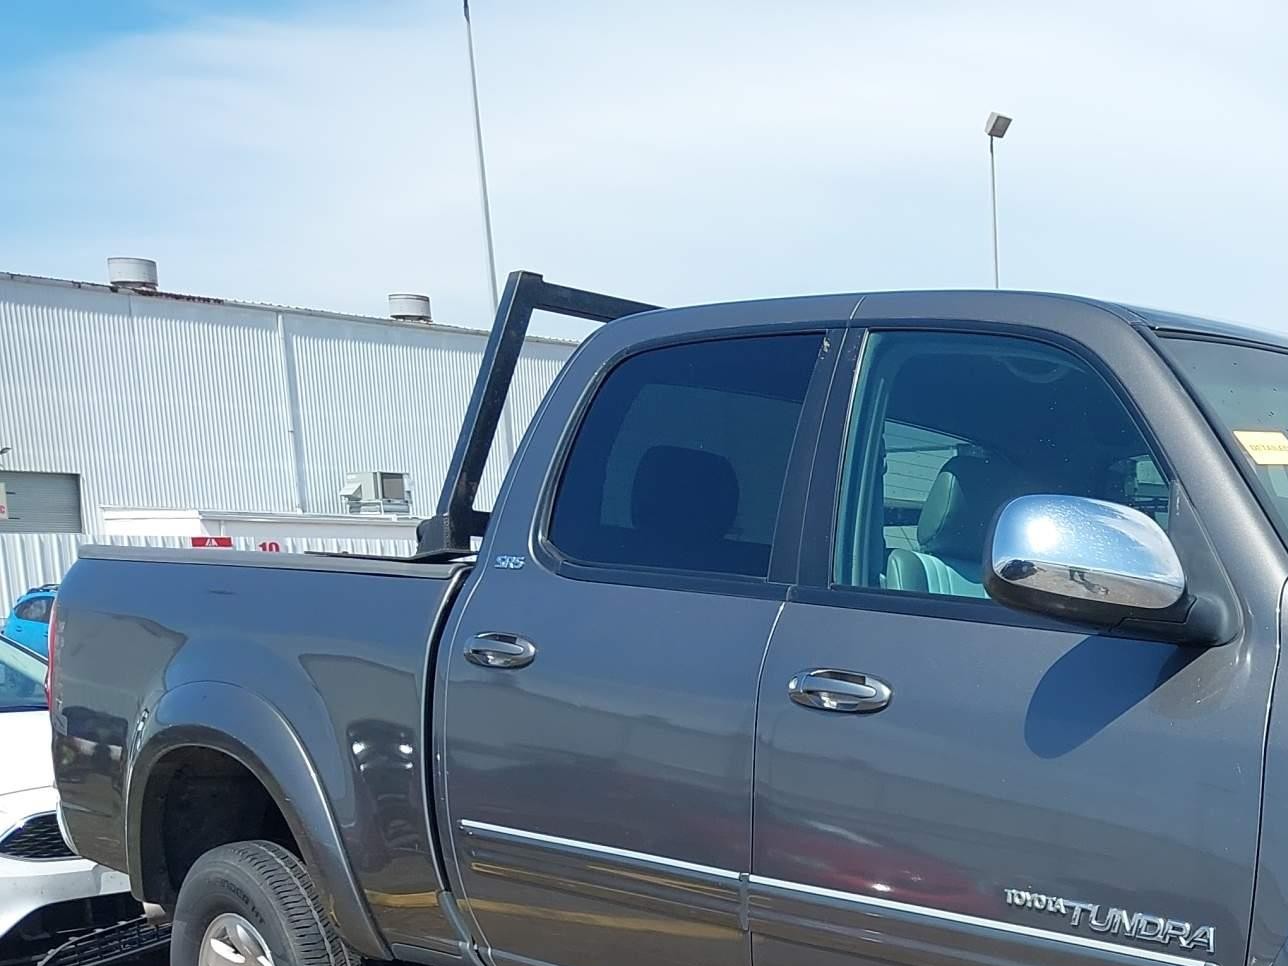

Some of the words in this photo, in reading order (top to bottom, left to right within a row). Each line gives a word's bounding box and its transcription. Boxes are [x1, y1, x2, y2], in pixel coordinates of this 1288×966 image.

[494, 555, 526, 569] SR5
[1004, 888, 1067, 914] TOYOTA
[1063, 898, 1217, 953] TUNDRA
